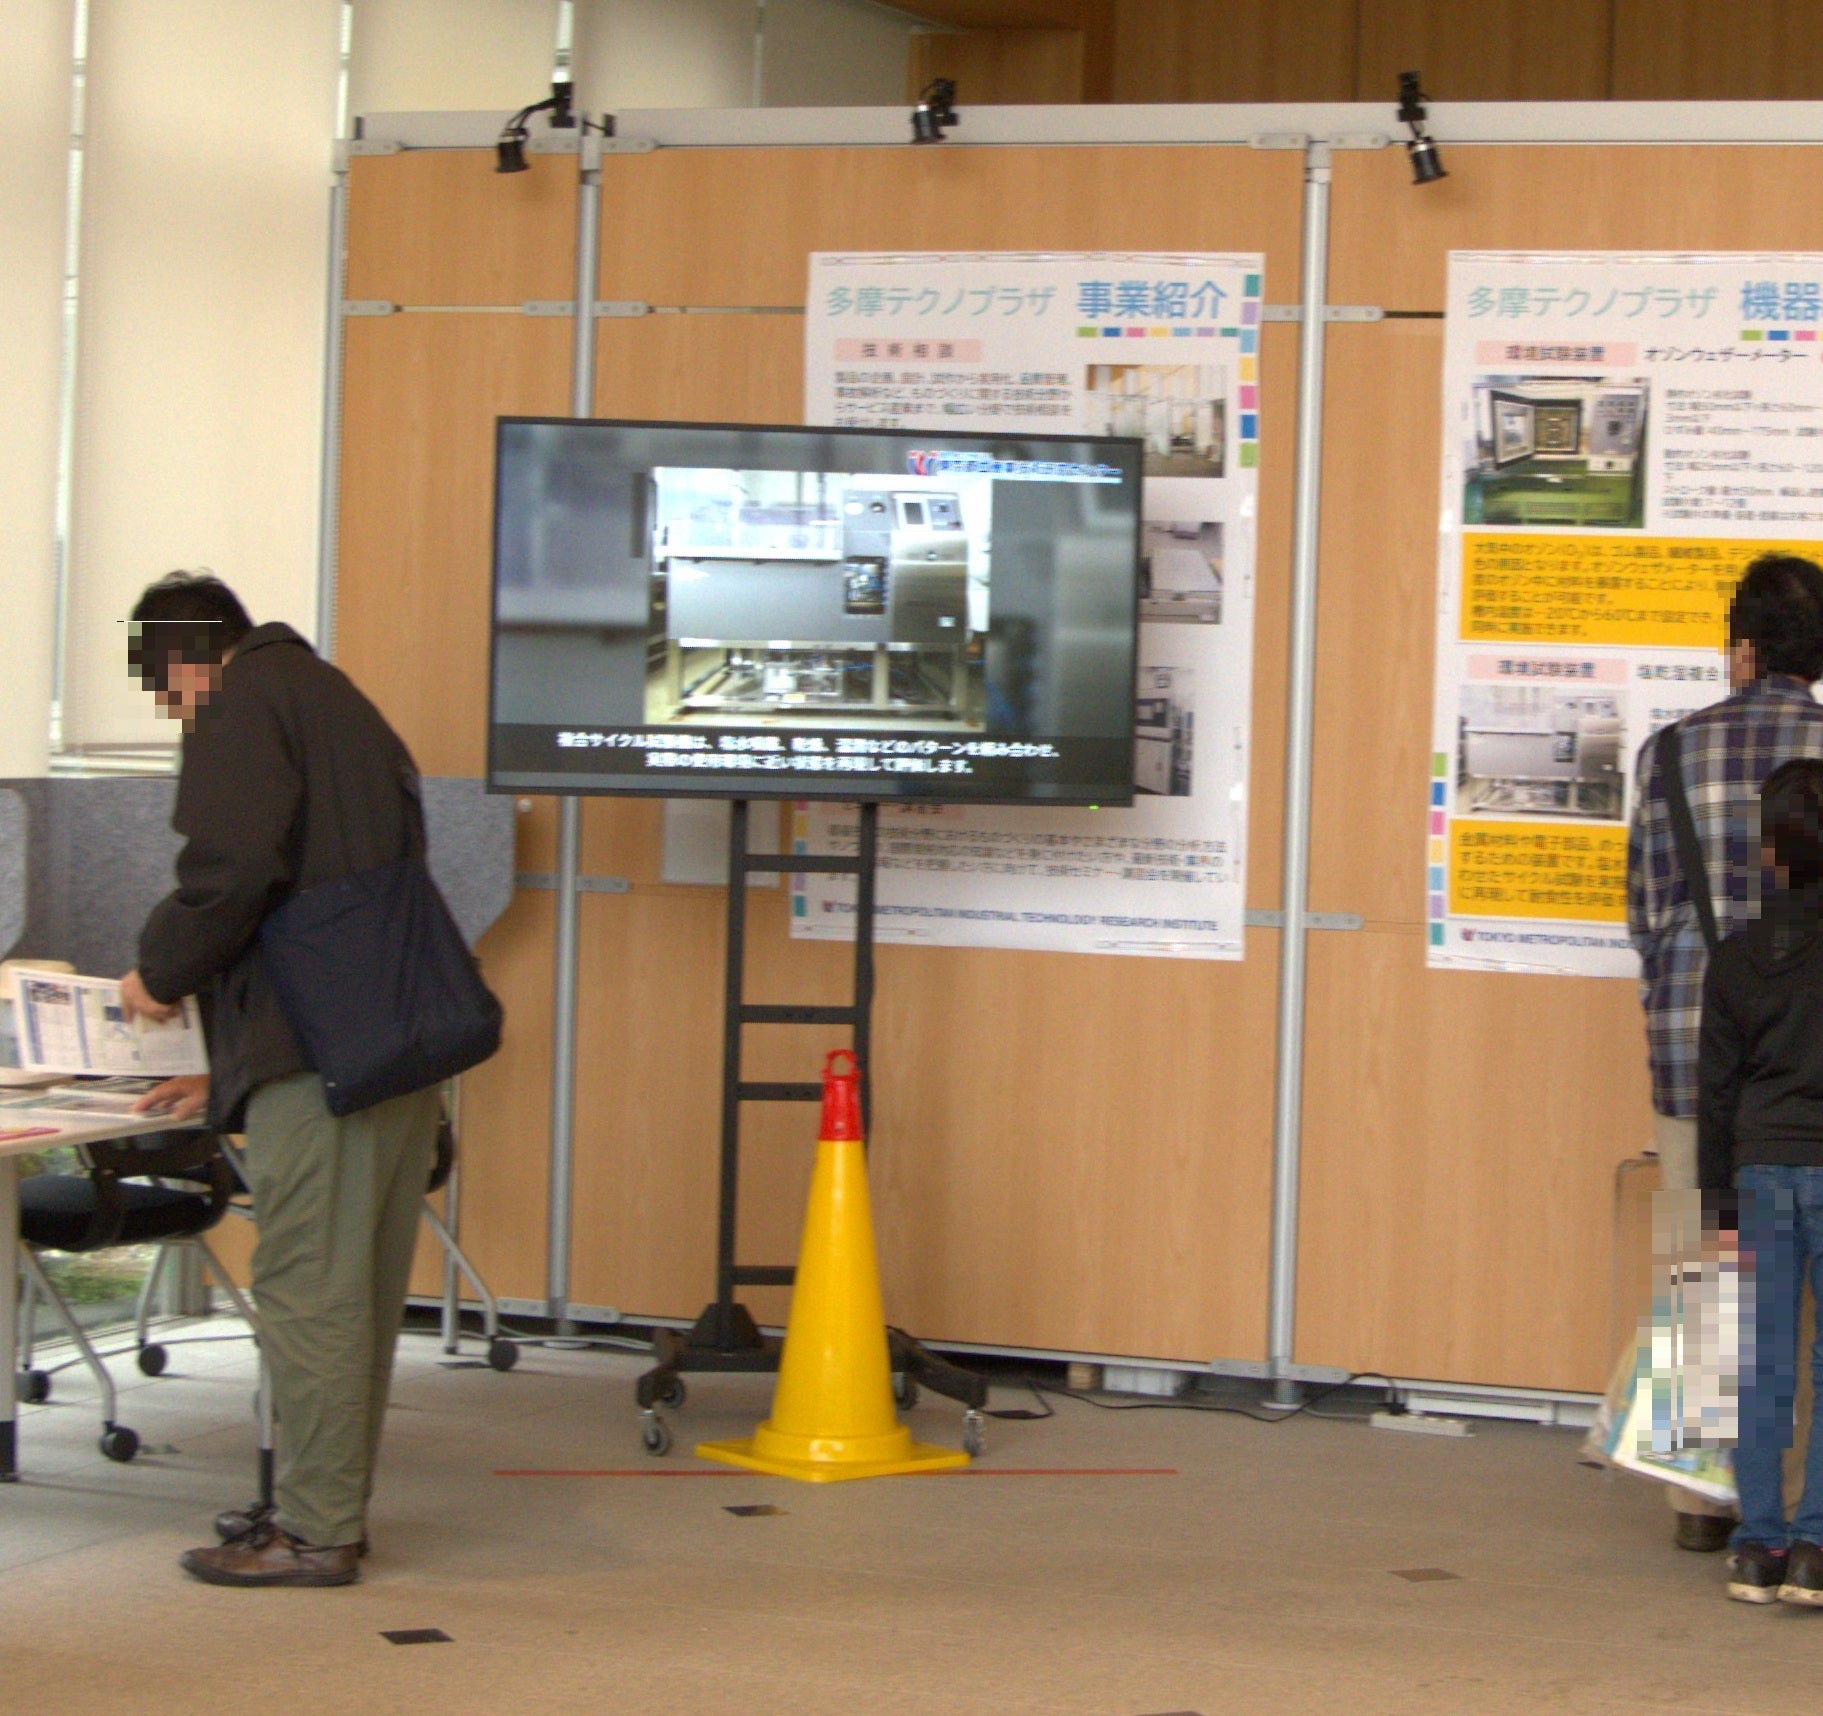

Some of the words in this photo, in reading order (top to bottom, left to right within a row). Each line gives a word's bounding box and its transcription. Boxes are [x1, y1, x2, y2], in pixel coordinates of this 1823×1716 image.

[825, 285, 1058, 317] 多摩テクノプラザ
[1076, 279, 1228, 319] 事業紹介
[1466, 286, 1719, 319] 多摩テクノプラザ
